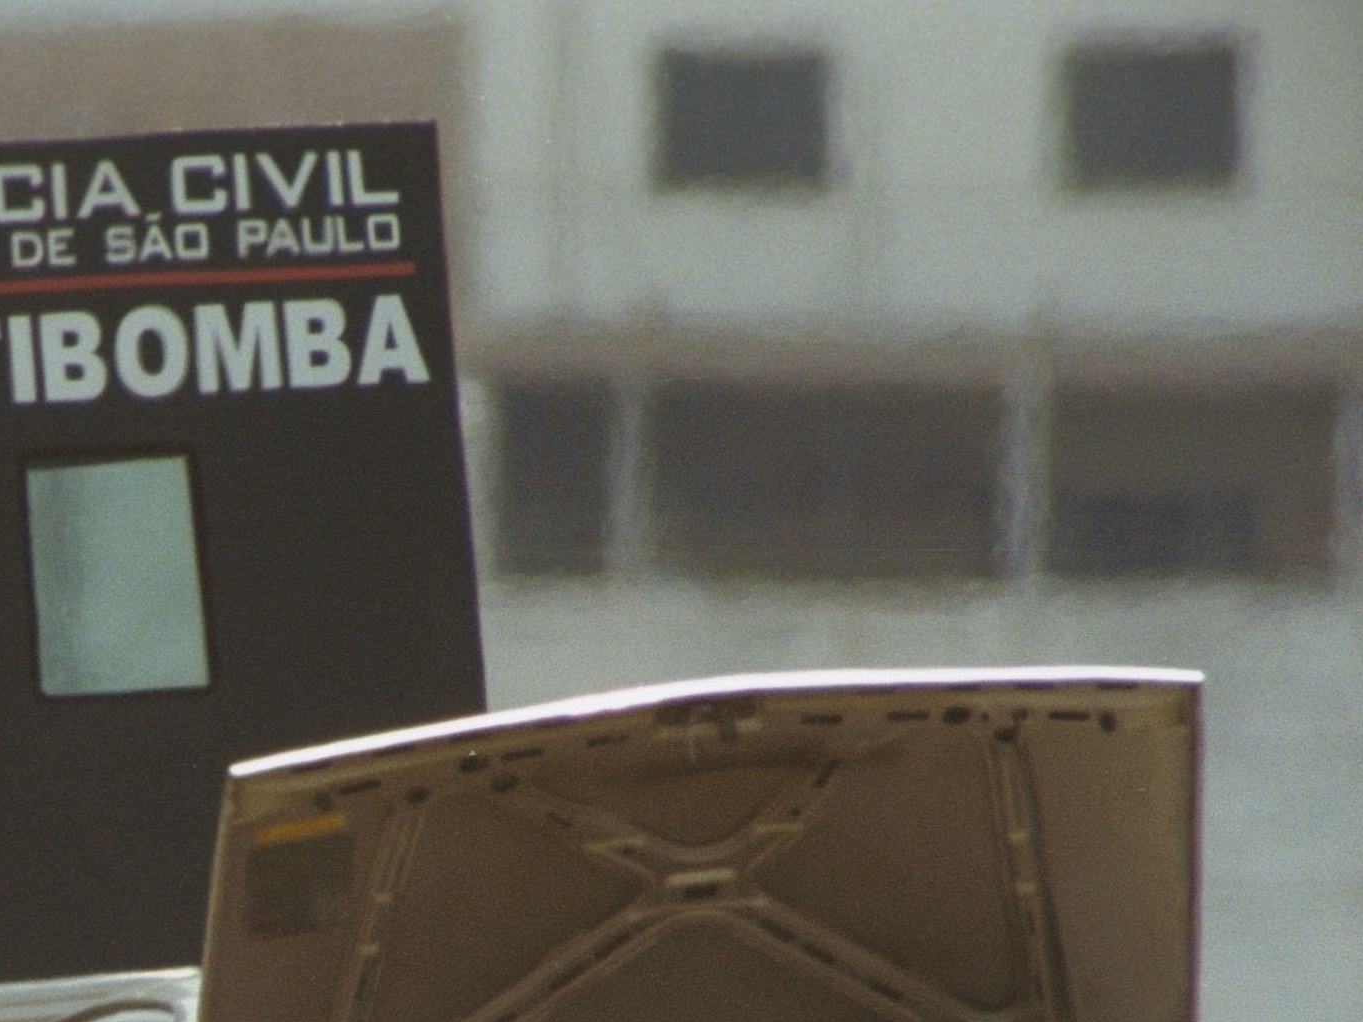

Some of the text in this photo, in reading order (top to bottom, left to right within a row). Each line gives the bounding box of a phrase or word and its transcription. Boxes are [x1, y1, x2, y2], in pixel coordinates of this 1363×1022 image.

[171, 150, 399, 214] CIVIL
[10, 227, 76, 268] DE
[105, 212, 210, 264] SÃO
[237, 213, 400, 258] PAULO
